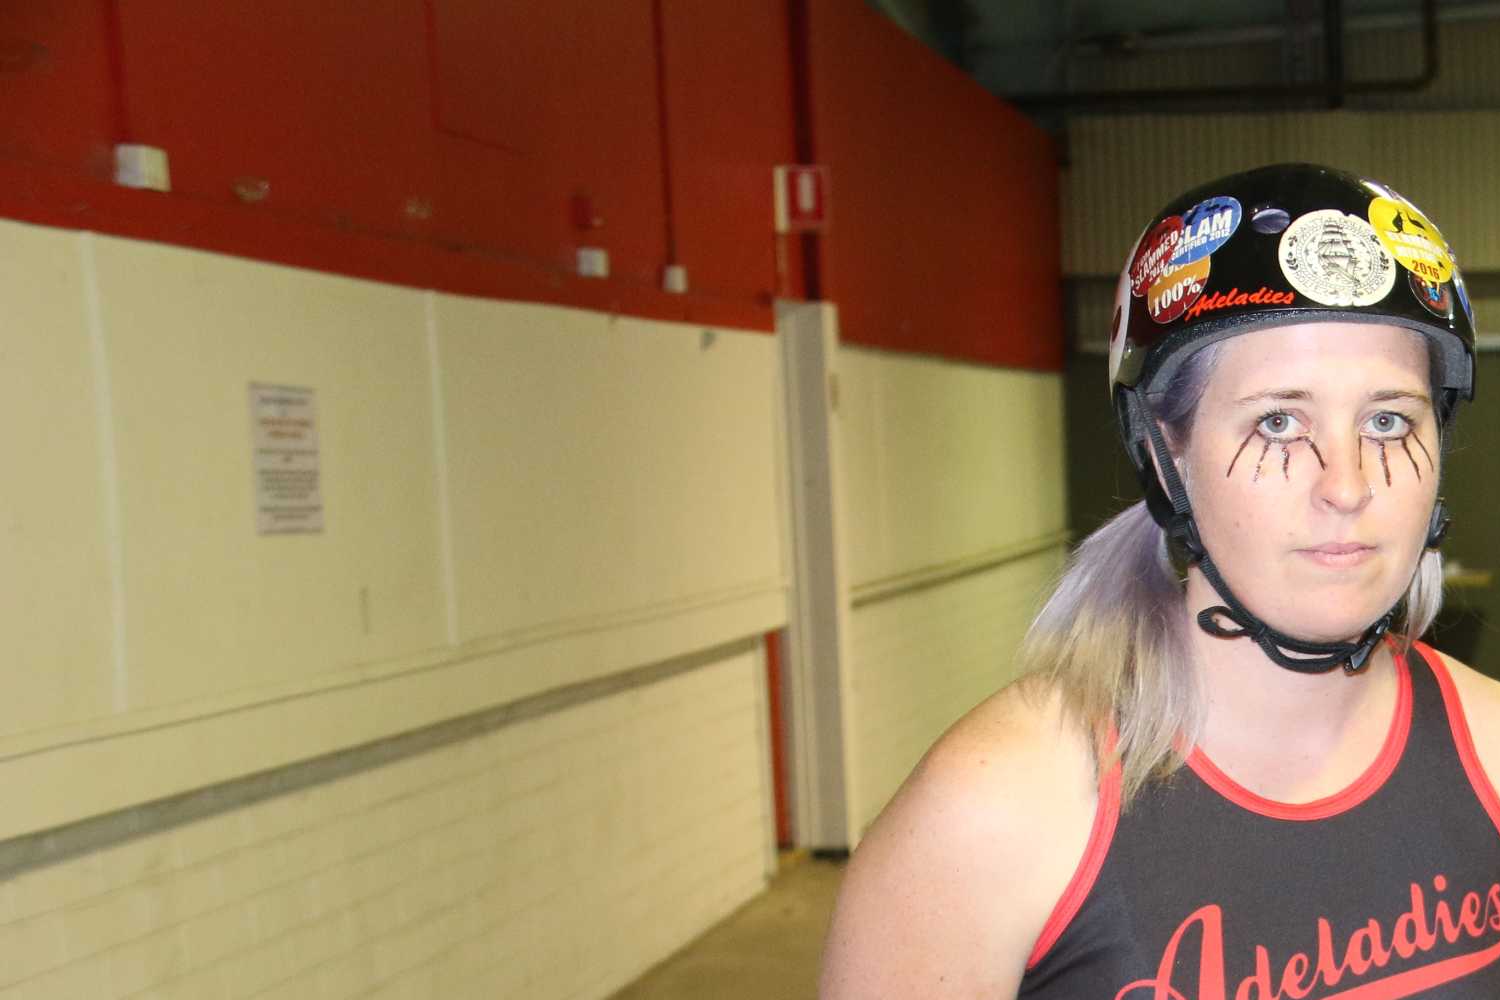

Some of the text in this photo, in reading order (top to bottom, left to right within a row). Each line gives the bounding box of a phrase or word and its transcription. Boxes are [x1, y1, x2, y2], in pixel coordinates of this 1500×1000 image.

[1411, 259, 1440, 280] 2016
[1153, 276, 1202, 317] 100%
[1184, 286, 1295, 322] Adeladies
